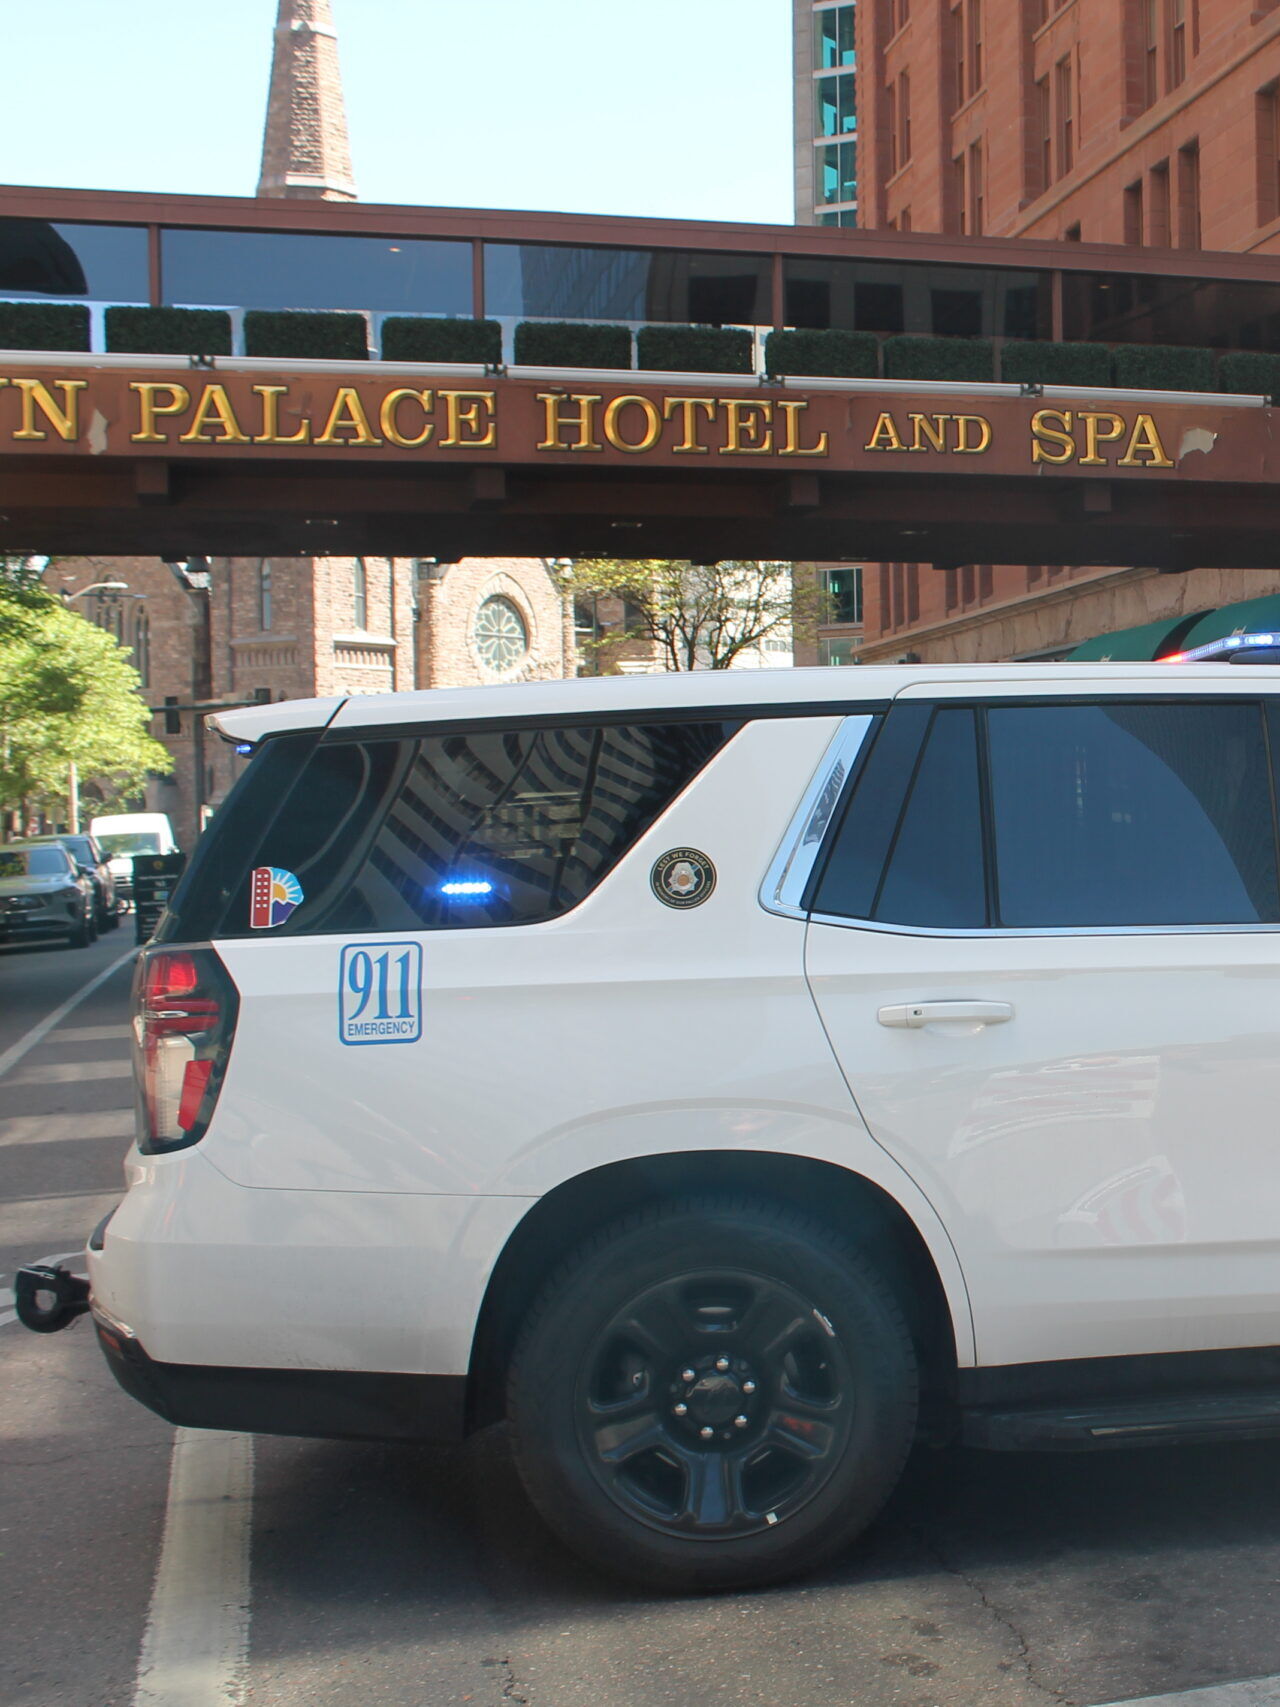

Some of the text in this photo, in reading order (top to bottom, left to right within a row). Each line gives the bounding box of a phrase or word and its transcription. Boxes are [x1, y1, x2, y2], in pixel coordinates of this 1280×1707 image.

[0, 378, 1176, 468] N PALACE HOTEL AND SPA
[657, 856, 671, 871] LEST
[685, 852, 710, 869] FORGET
[348, 950, 415, 1021] 911
[347, 1021, 416, 1037] EMERGENCY
